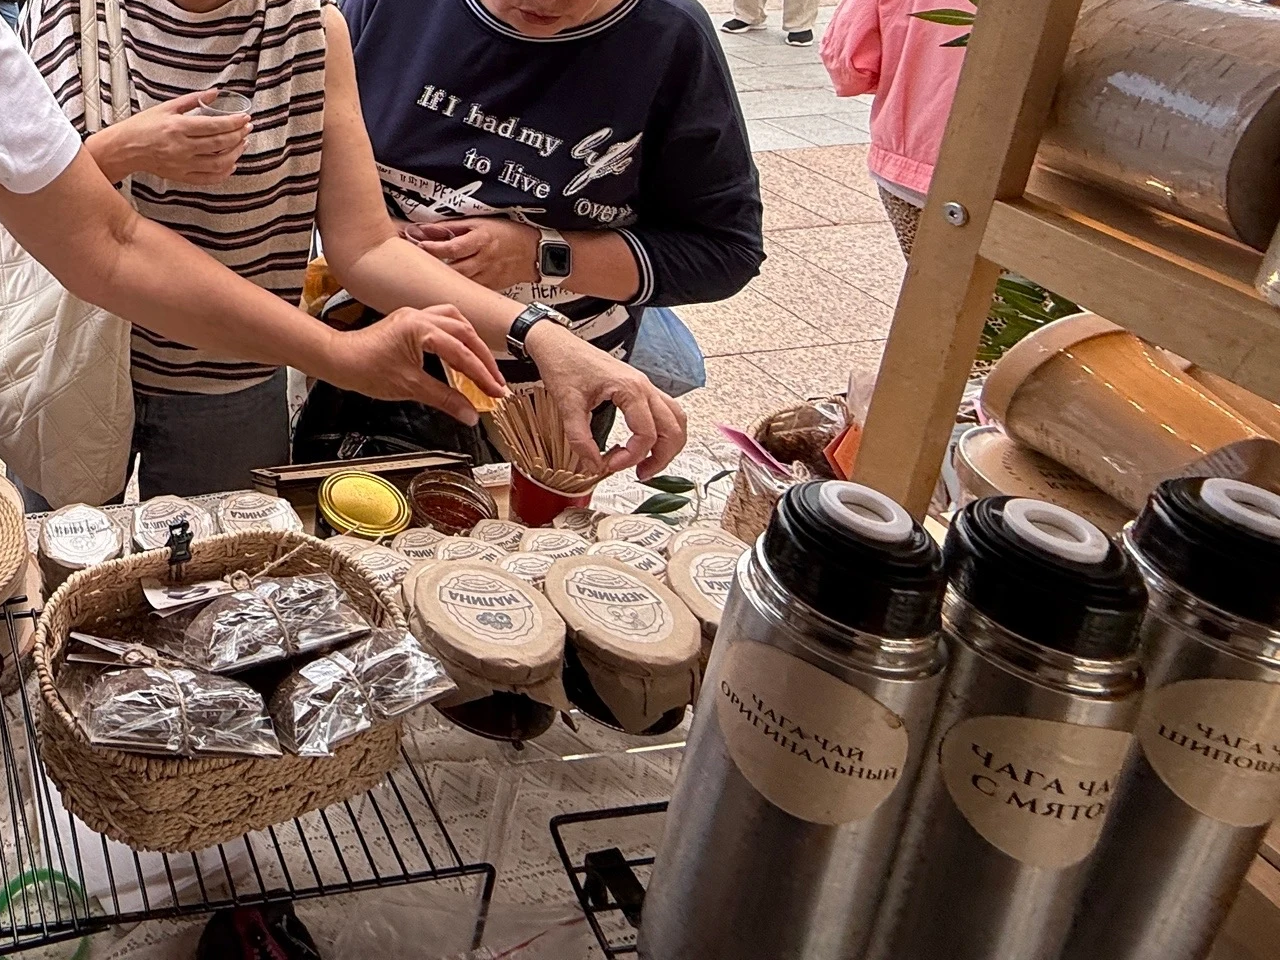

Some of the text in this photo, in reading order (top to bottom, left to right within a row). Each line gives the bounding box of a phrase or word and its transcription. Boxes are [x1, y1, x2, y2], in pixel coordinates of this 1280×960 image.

[417, 84, 447, 112] If
[442, 95, 463, 118] I
[463, 103, 519, 140] had
[516, 126, 564, 157] my
[463, 148, 551, 199] to live
[230, 506, 280, 521] ЧЕРНИКА
[448, 589, 522, 607] МАЛИНА
[575, 584, 650, 603] ЧЕРНИКА
[721, 680, 898, 780] ОРИГИНАЛЬНЫЙ
[752, 693, 865, 762] ЧАГА ЧАЙ
[1196, 722, 1263, 755] ЧАГА
[970, 742, 1065, 795] ЧАГА
[971, 774, 999, 797] С
